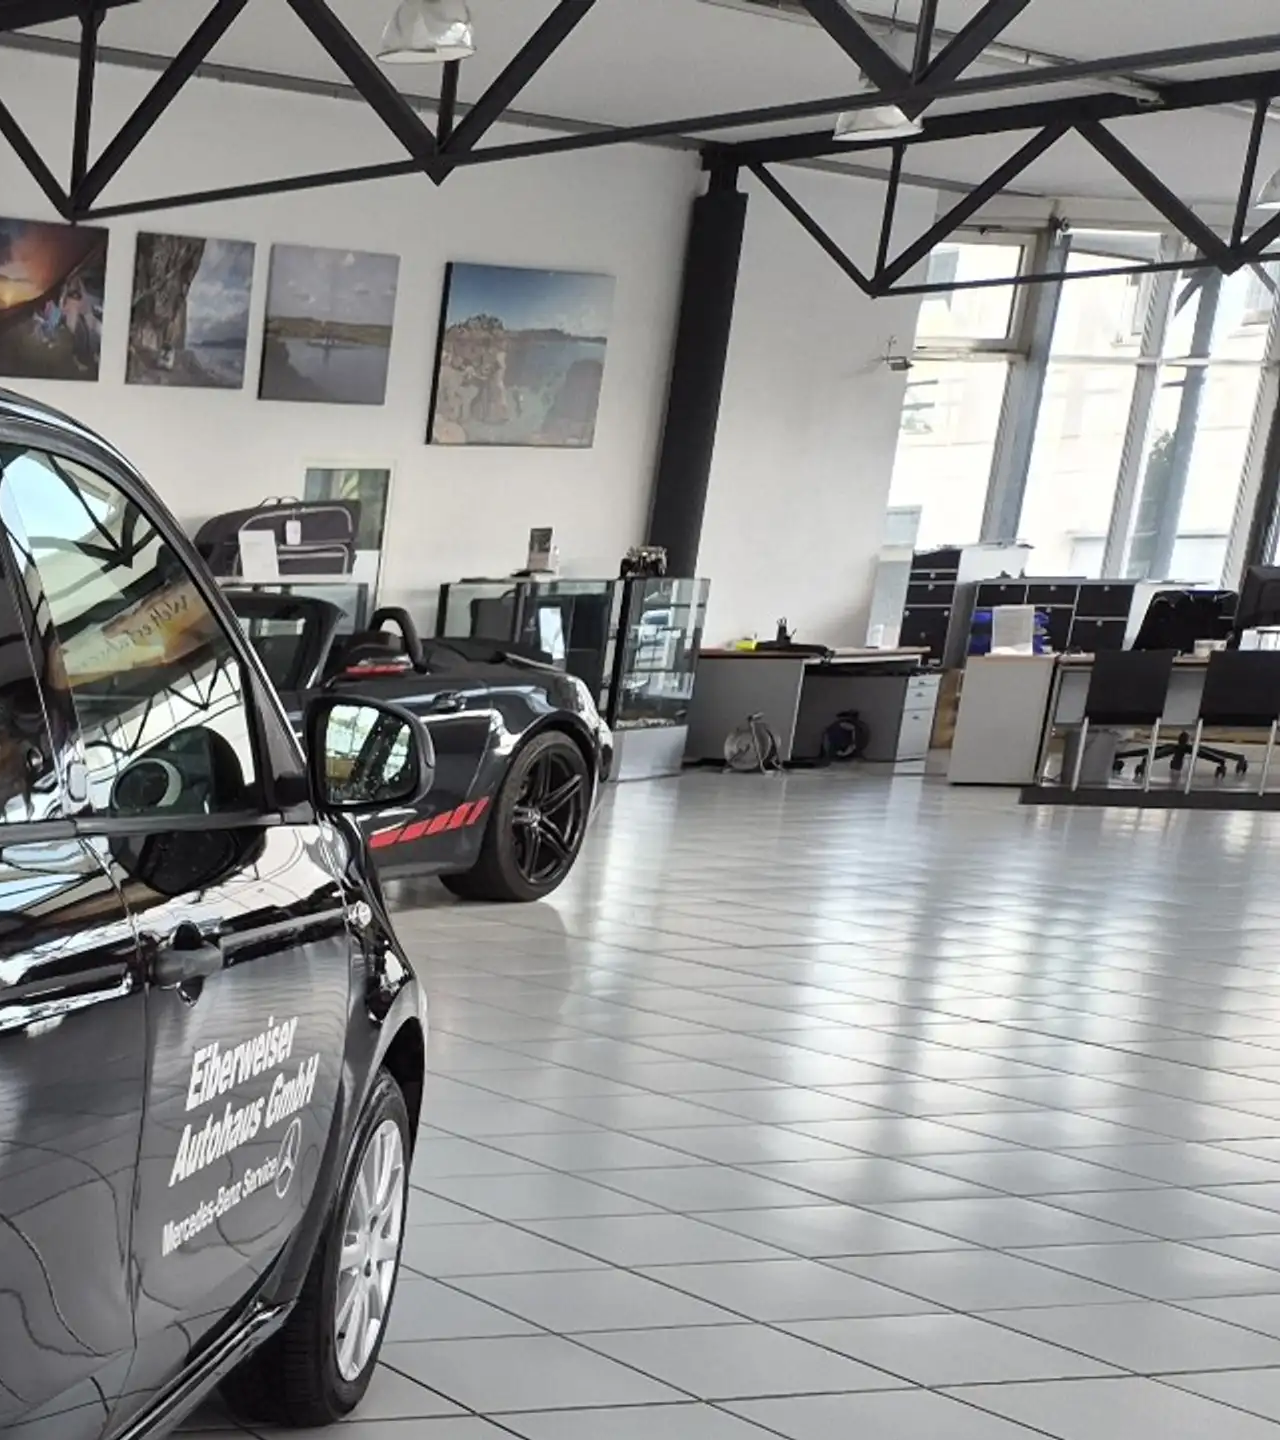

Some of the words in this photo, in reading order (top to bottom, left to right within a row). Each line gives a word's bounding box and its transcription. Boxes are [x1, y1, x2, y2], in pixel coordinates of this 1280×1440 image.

[185, 1015, 299, 1111] Eiberweiser
[168, 1097, 265, 1187] Autohaus
[265, 1052, 320, 1129] GmbH
[161, 1179, 242, 1257] Mercedes-Benz
[242, 1155, 278, 1197] Service
